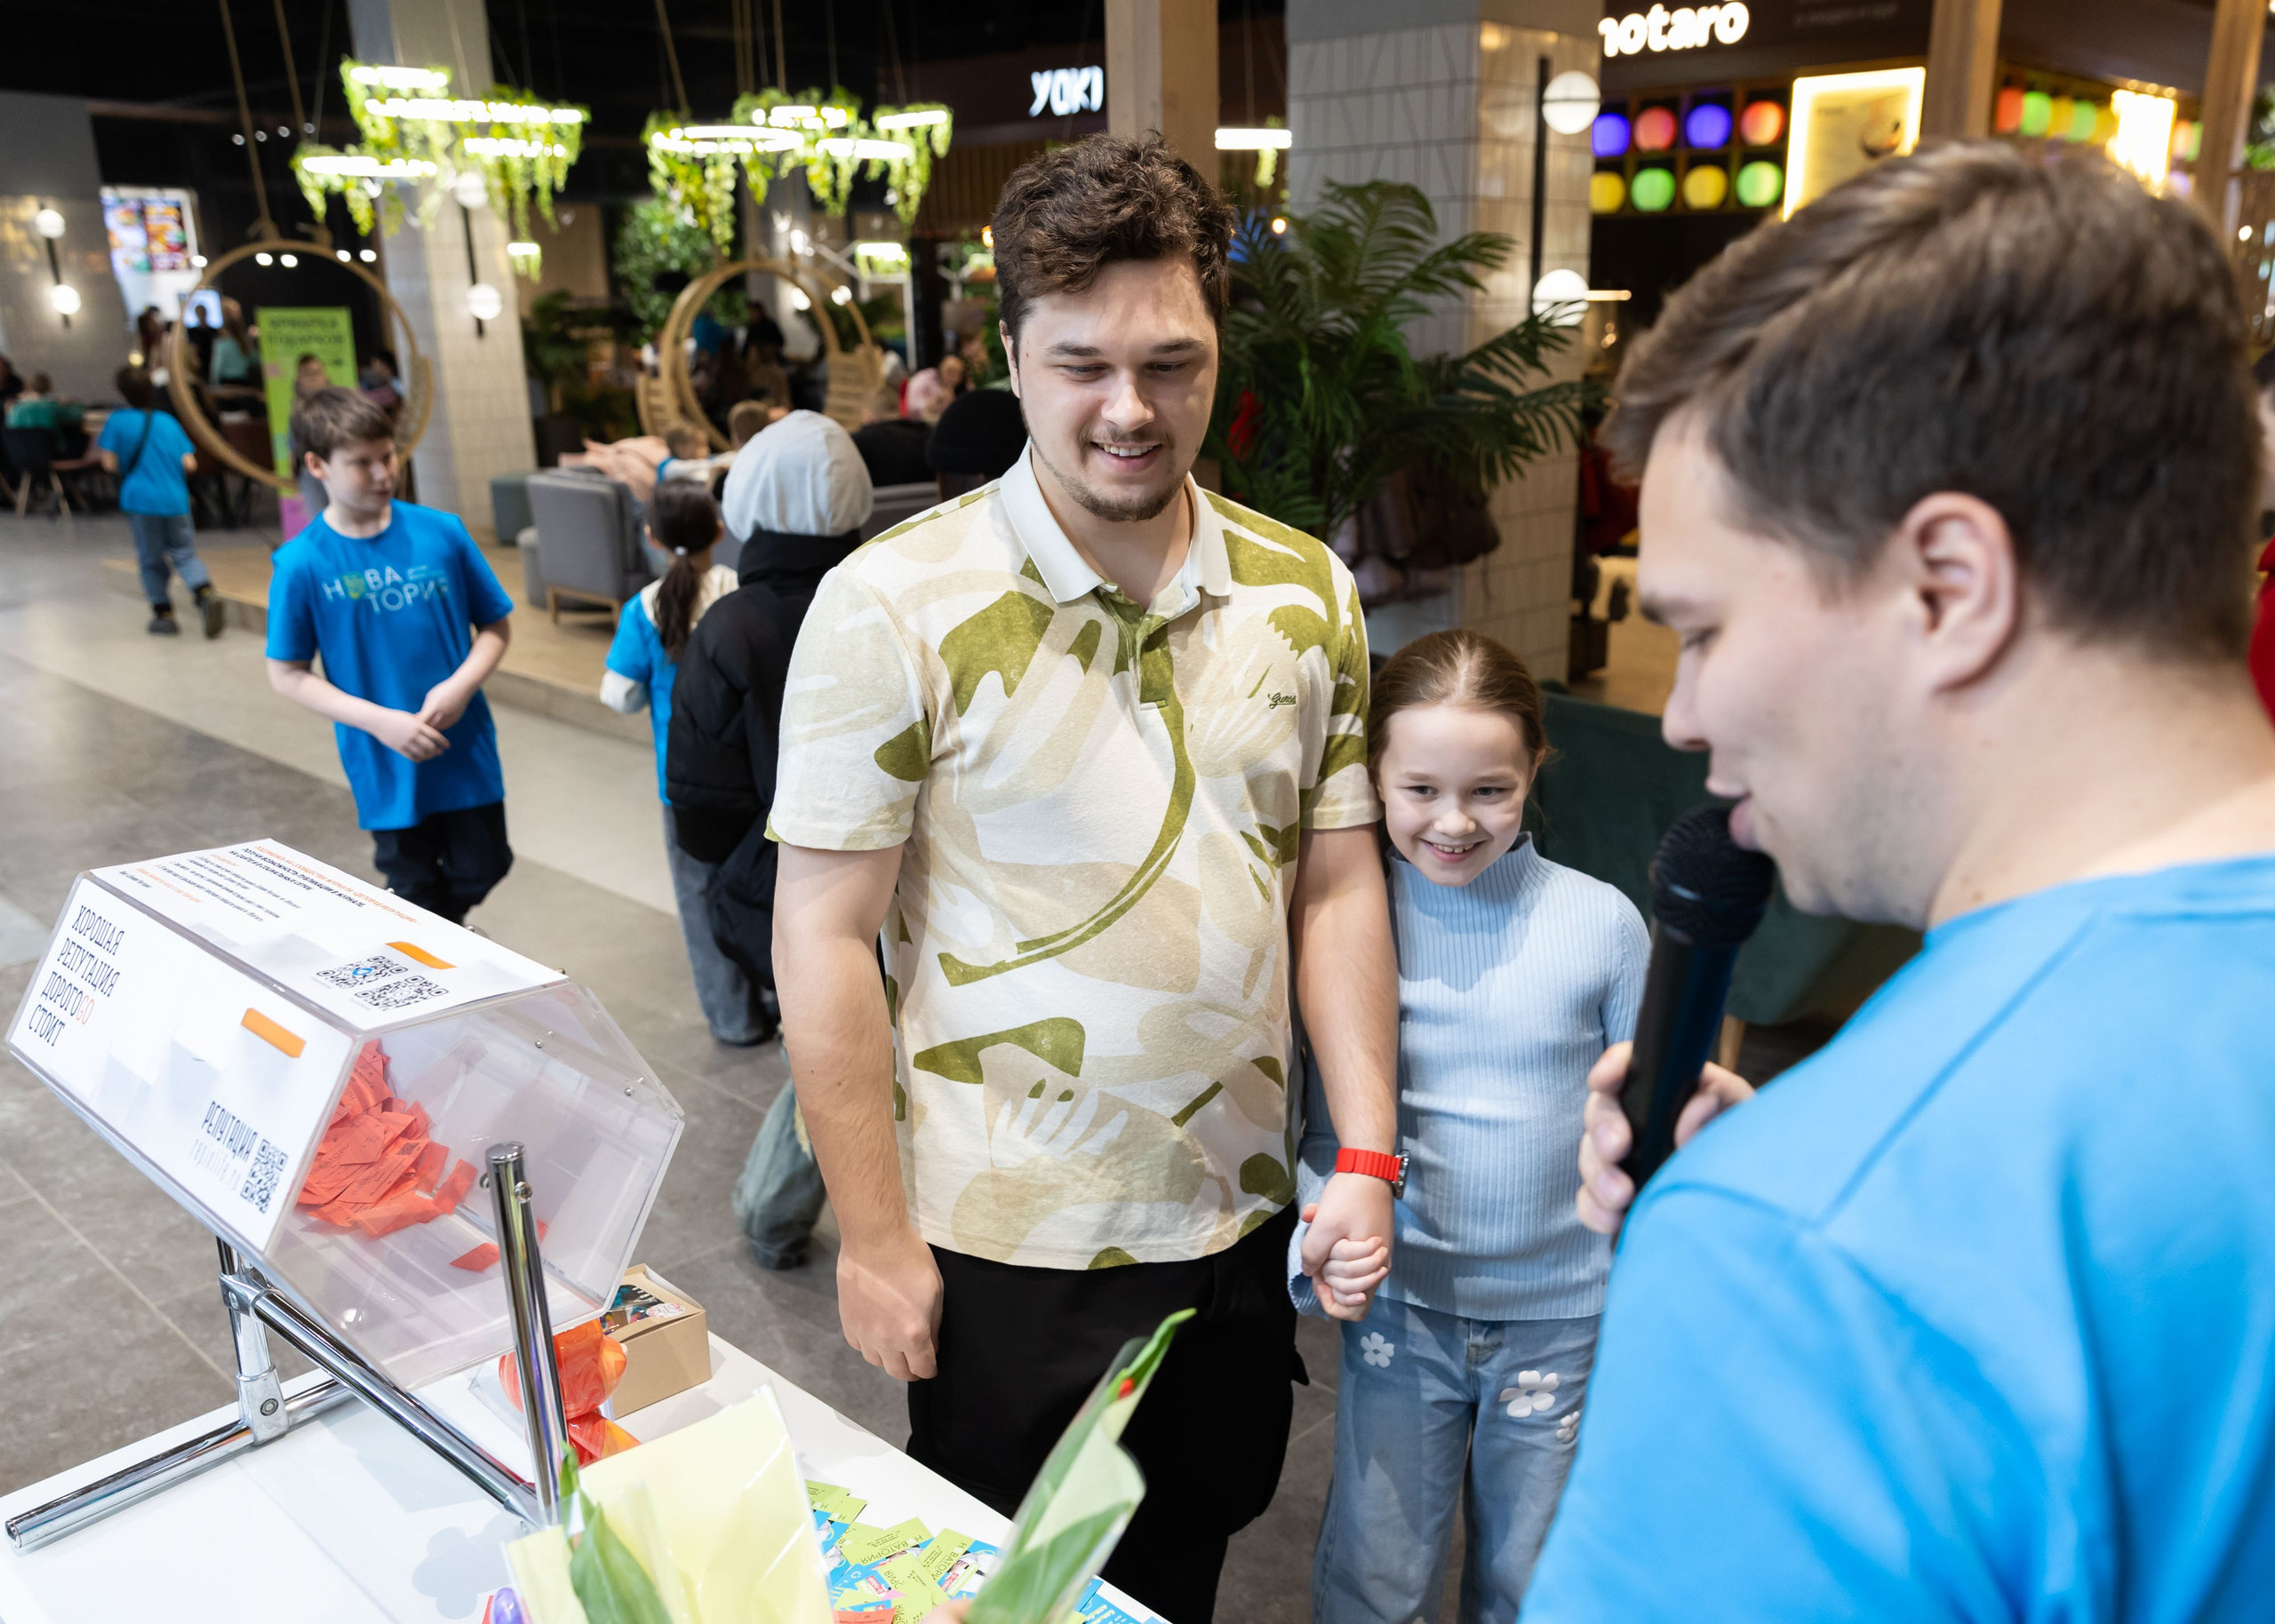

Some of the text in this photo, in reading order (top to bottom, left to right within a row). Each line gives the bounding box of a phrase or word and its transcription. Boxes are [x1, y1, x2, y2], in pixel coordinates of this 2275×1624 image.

[72, 905, 125, 956] ХОРОШАЯ
[57, 937, 121, 998] РЕПУТАЦИЯ
[28, 1004, 66, 1047] СТОИТ
